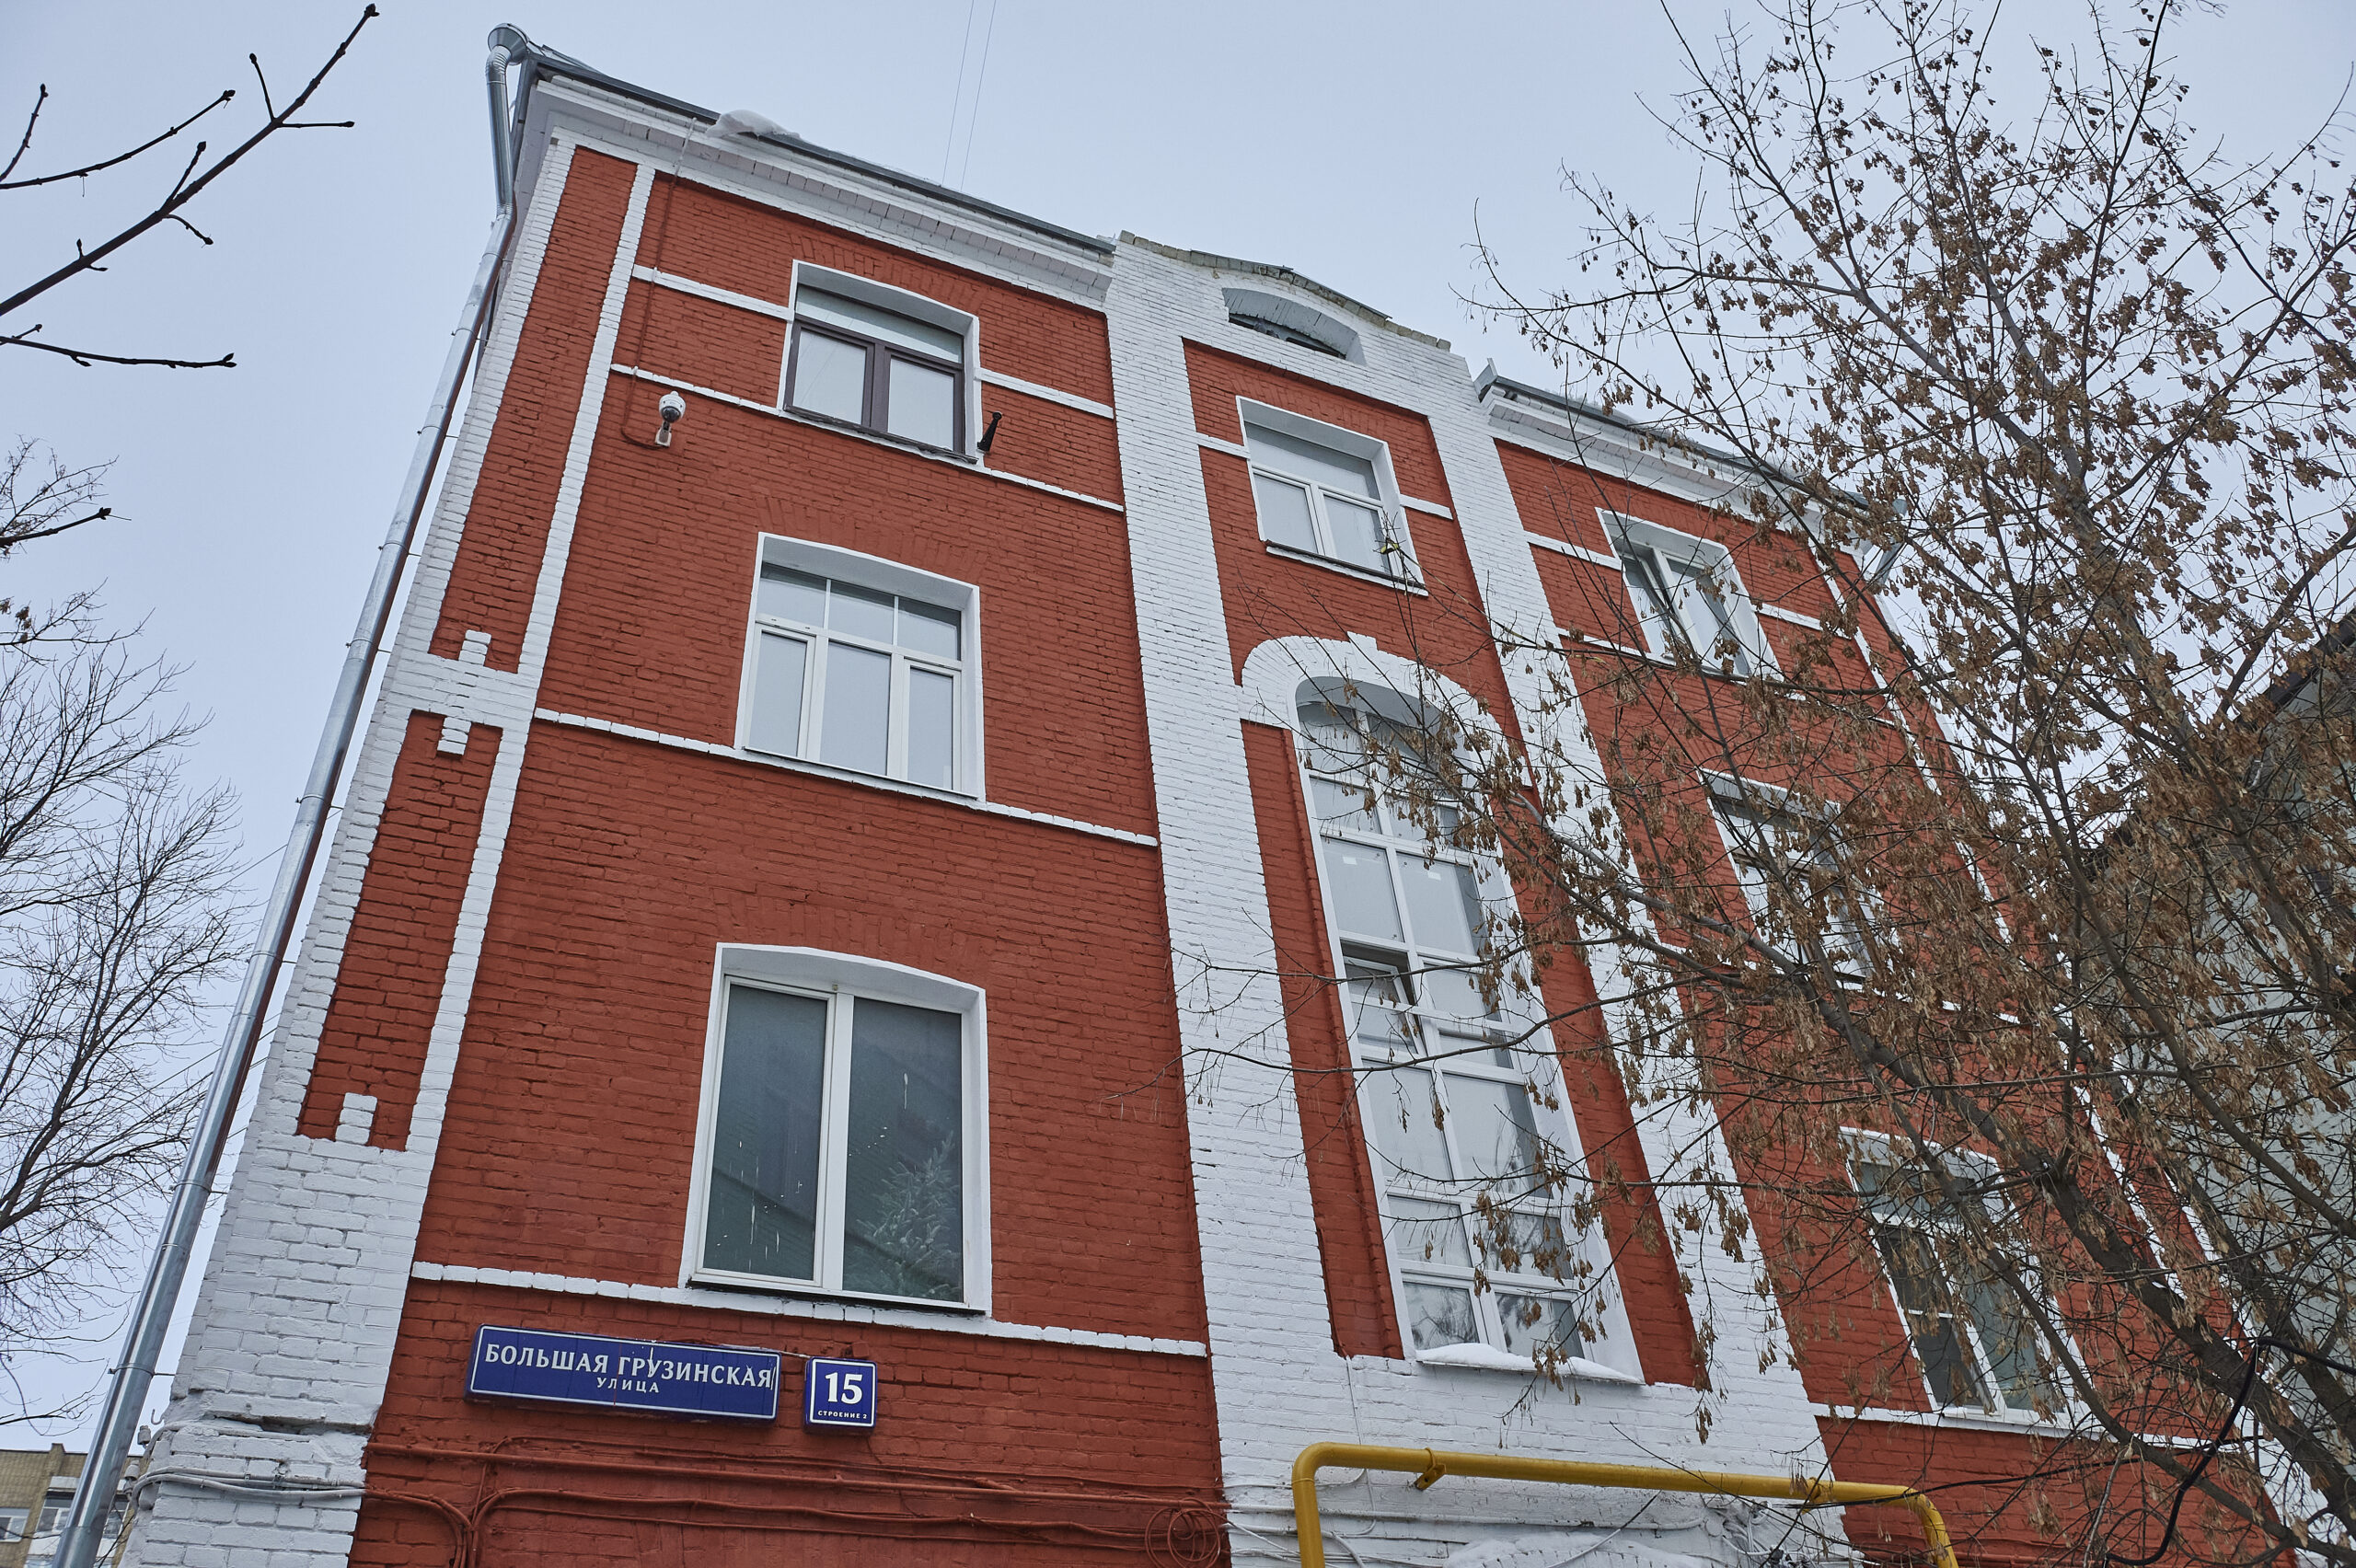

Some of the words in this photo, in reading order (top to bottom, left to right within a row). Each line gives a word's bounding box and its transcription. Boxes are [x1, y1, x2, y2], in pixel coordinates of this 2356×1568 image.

[484, 1343, 608, 1374] БОЛЬШАЯ
[618, 1356, 771, 1389] ГРУЗИНСКАЯ
[596, 1377, 660, 1393] УЛИЦА
[826, 1371, 862, 1404] 15
[817, 1410, 860, 1419] СТРОЕНИЕ
